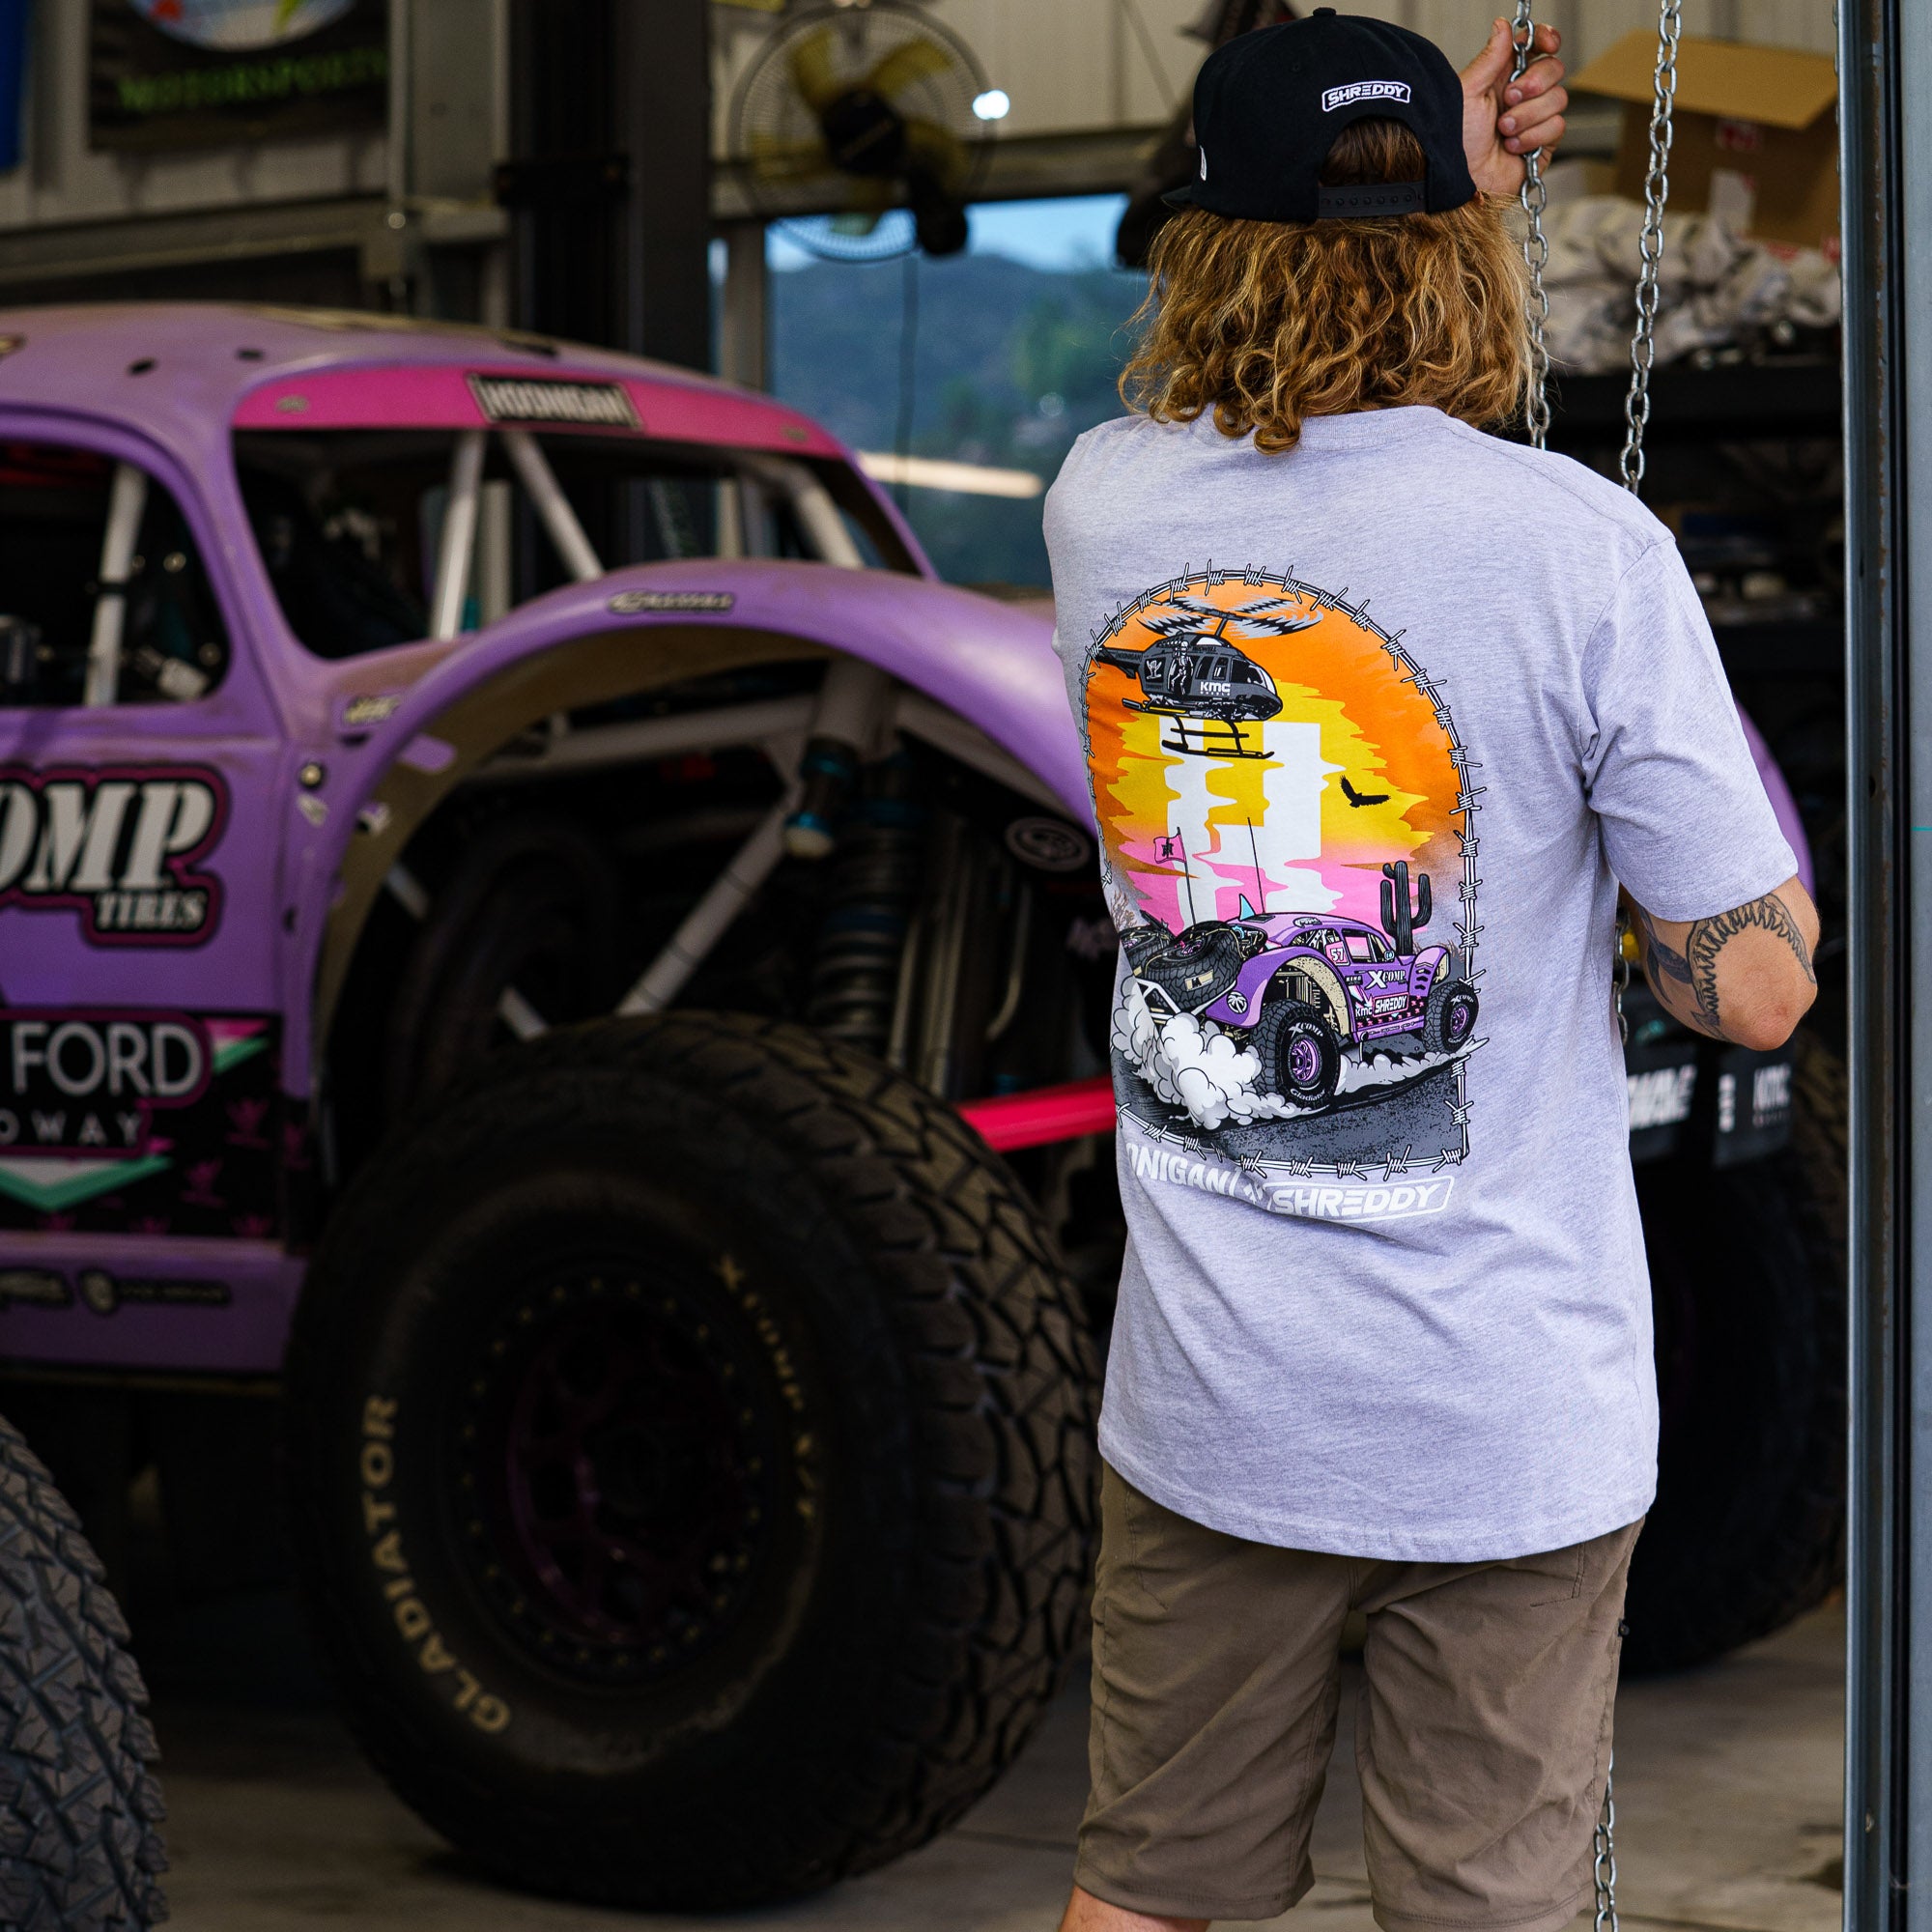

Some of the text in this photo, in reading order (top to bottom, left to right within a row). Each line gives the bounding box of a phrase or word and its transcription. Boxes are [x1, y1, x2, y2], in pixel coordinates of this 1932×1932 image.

[1327, 84, 1406, 106] SHREDDY
[99, 890, 207, 931] TIRES
[1330, 948, 1345, 962] 57
[1375, 996, 1407, 1014] SHREDDY
[12, 1021, 203, 1097] FORD
[1290, 1088, 1325, 1101] Gladiator
[1272, 1183, 1441, 1217] SHREDDY
[359, 1394, 510, 1733] GLADIATOR
